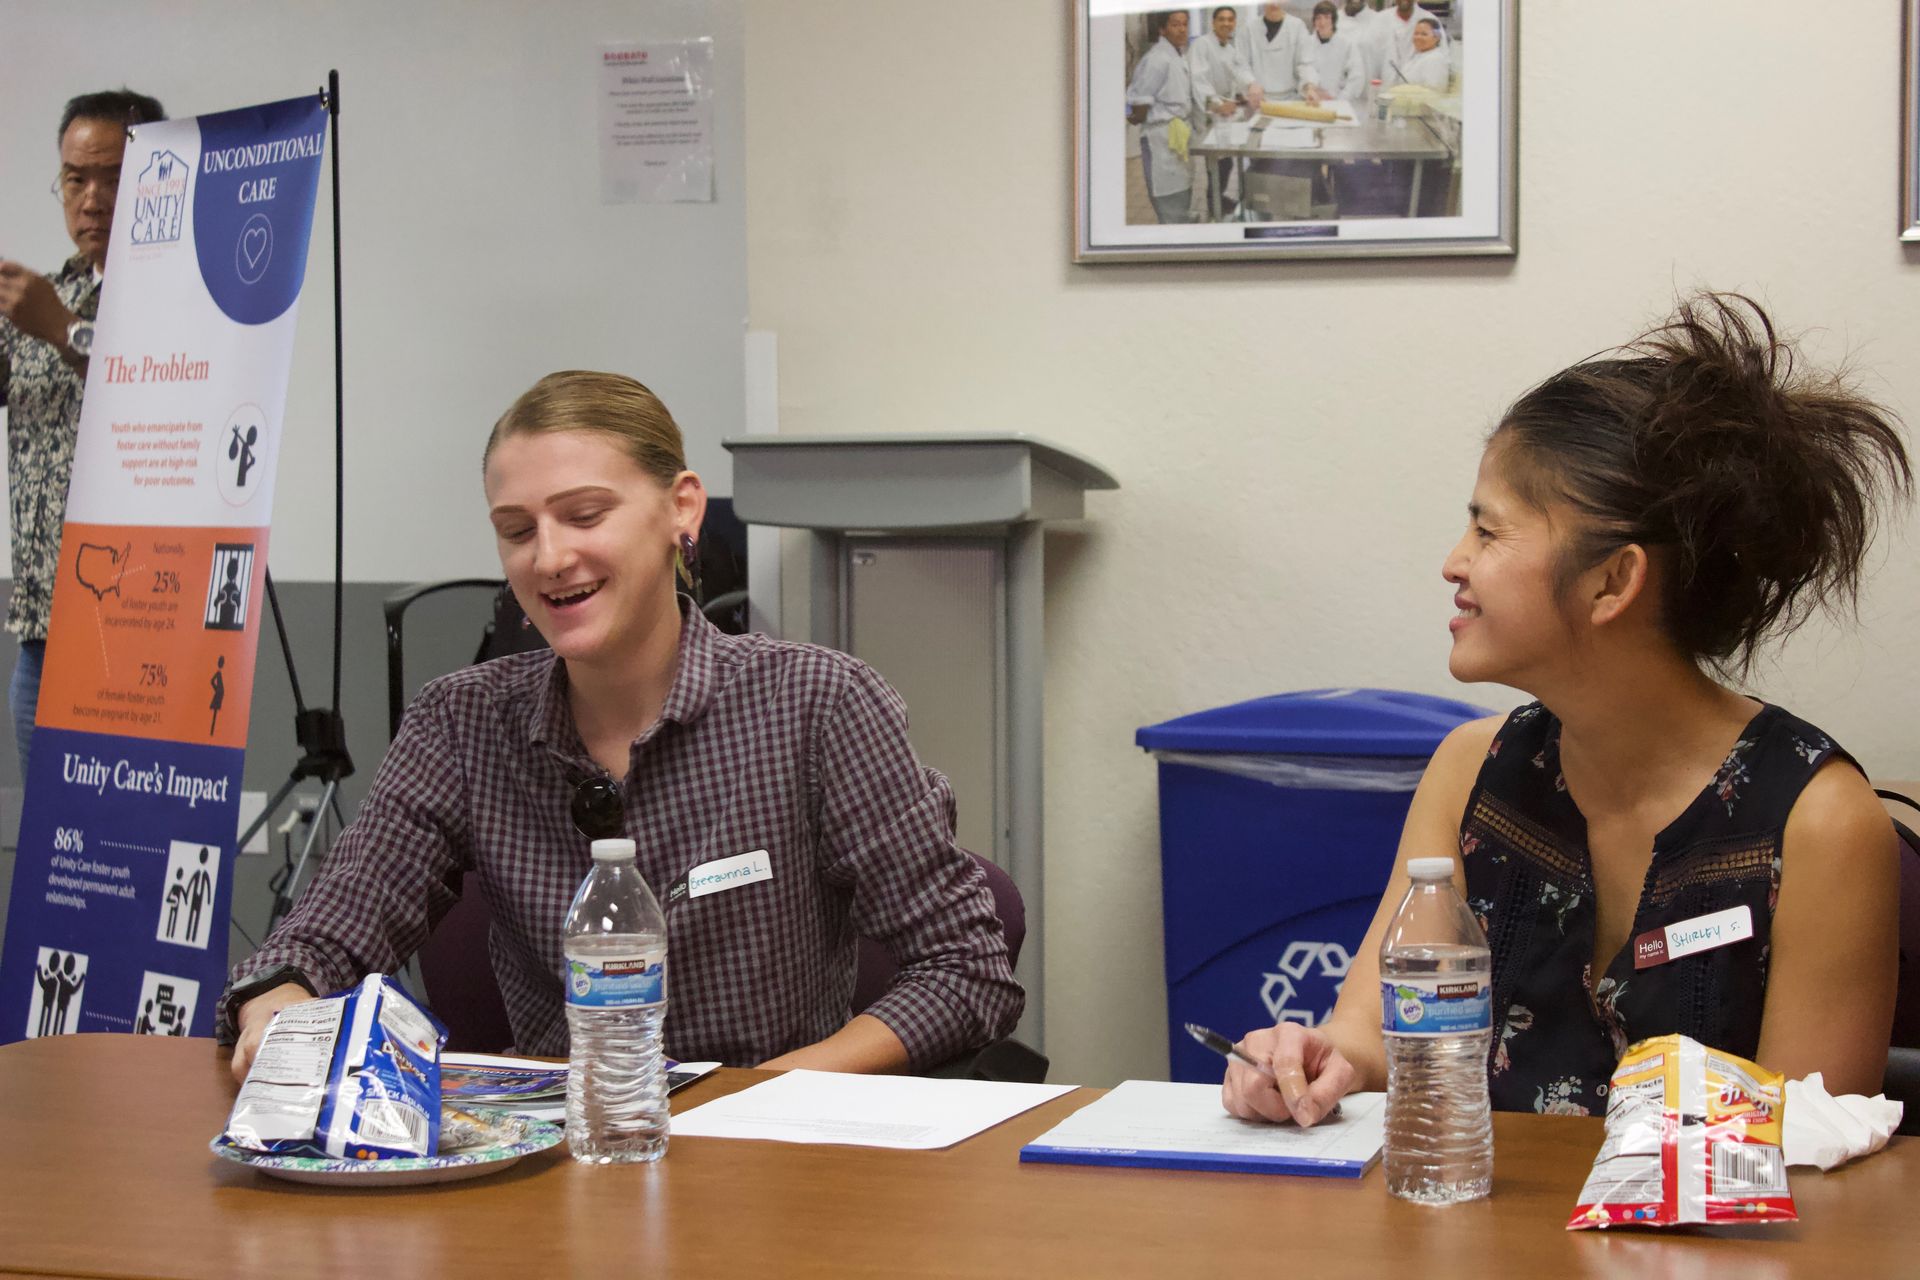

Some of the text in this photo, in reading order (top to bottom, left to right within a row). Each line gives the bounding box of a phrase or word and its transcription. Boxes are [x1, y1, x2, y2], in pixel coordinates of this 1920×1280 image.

[204, 132, 322, 174] UNCONDITIONAL
[238, 176, 278, 204] CARE
[134, 193, 184, 220] UNITY
[130, 217, 179, 242] CARE
[104, 351, 210, 384] The Problem
[111, 422, 129, 433] Youth
[147, 421, 186, 435] emancipate
[152, 570, 181, 594] 25%
[139, 663, 168, 688] 75%
[63, 753, 228, 808] Unity Care's Impact
[54, 825, 84, 854] 86%
[1639, 939, 1664, 954] Hello
[1671, 925, 1720, 948] SHIRLEY
[605, 961, 645, 971] KIRKLAND
[1439, 984, 1478, 994] KIRKLAND
[366, 1087, 401, 1100] SNCK
